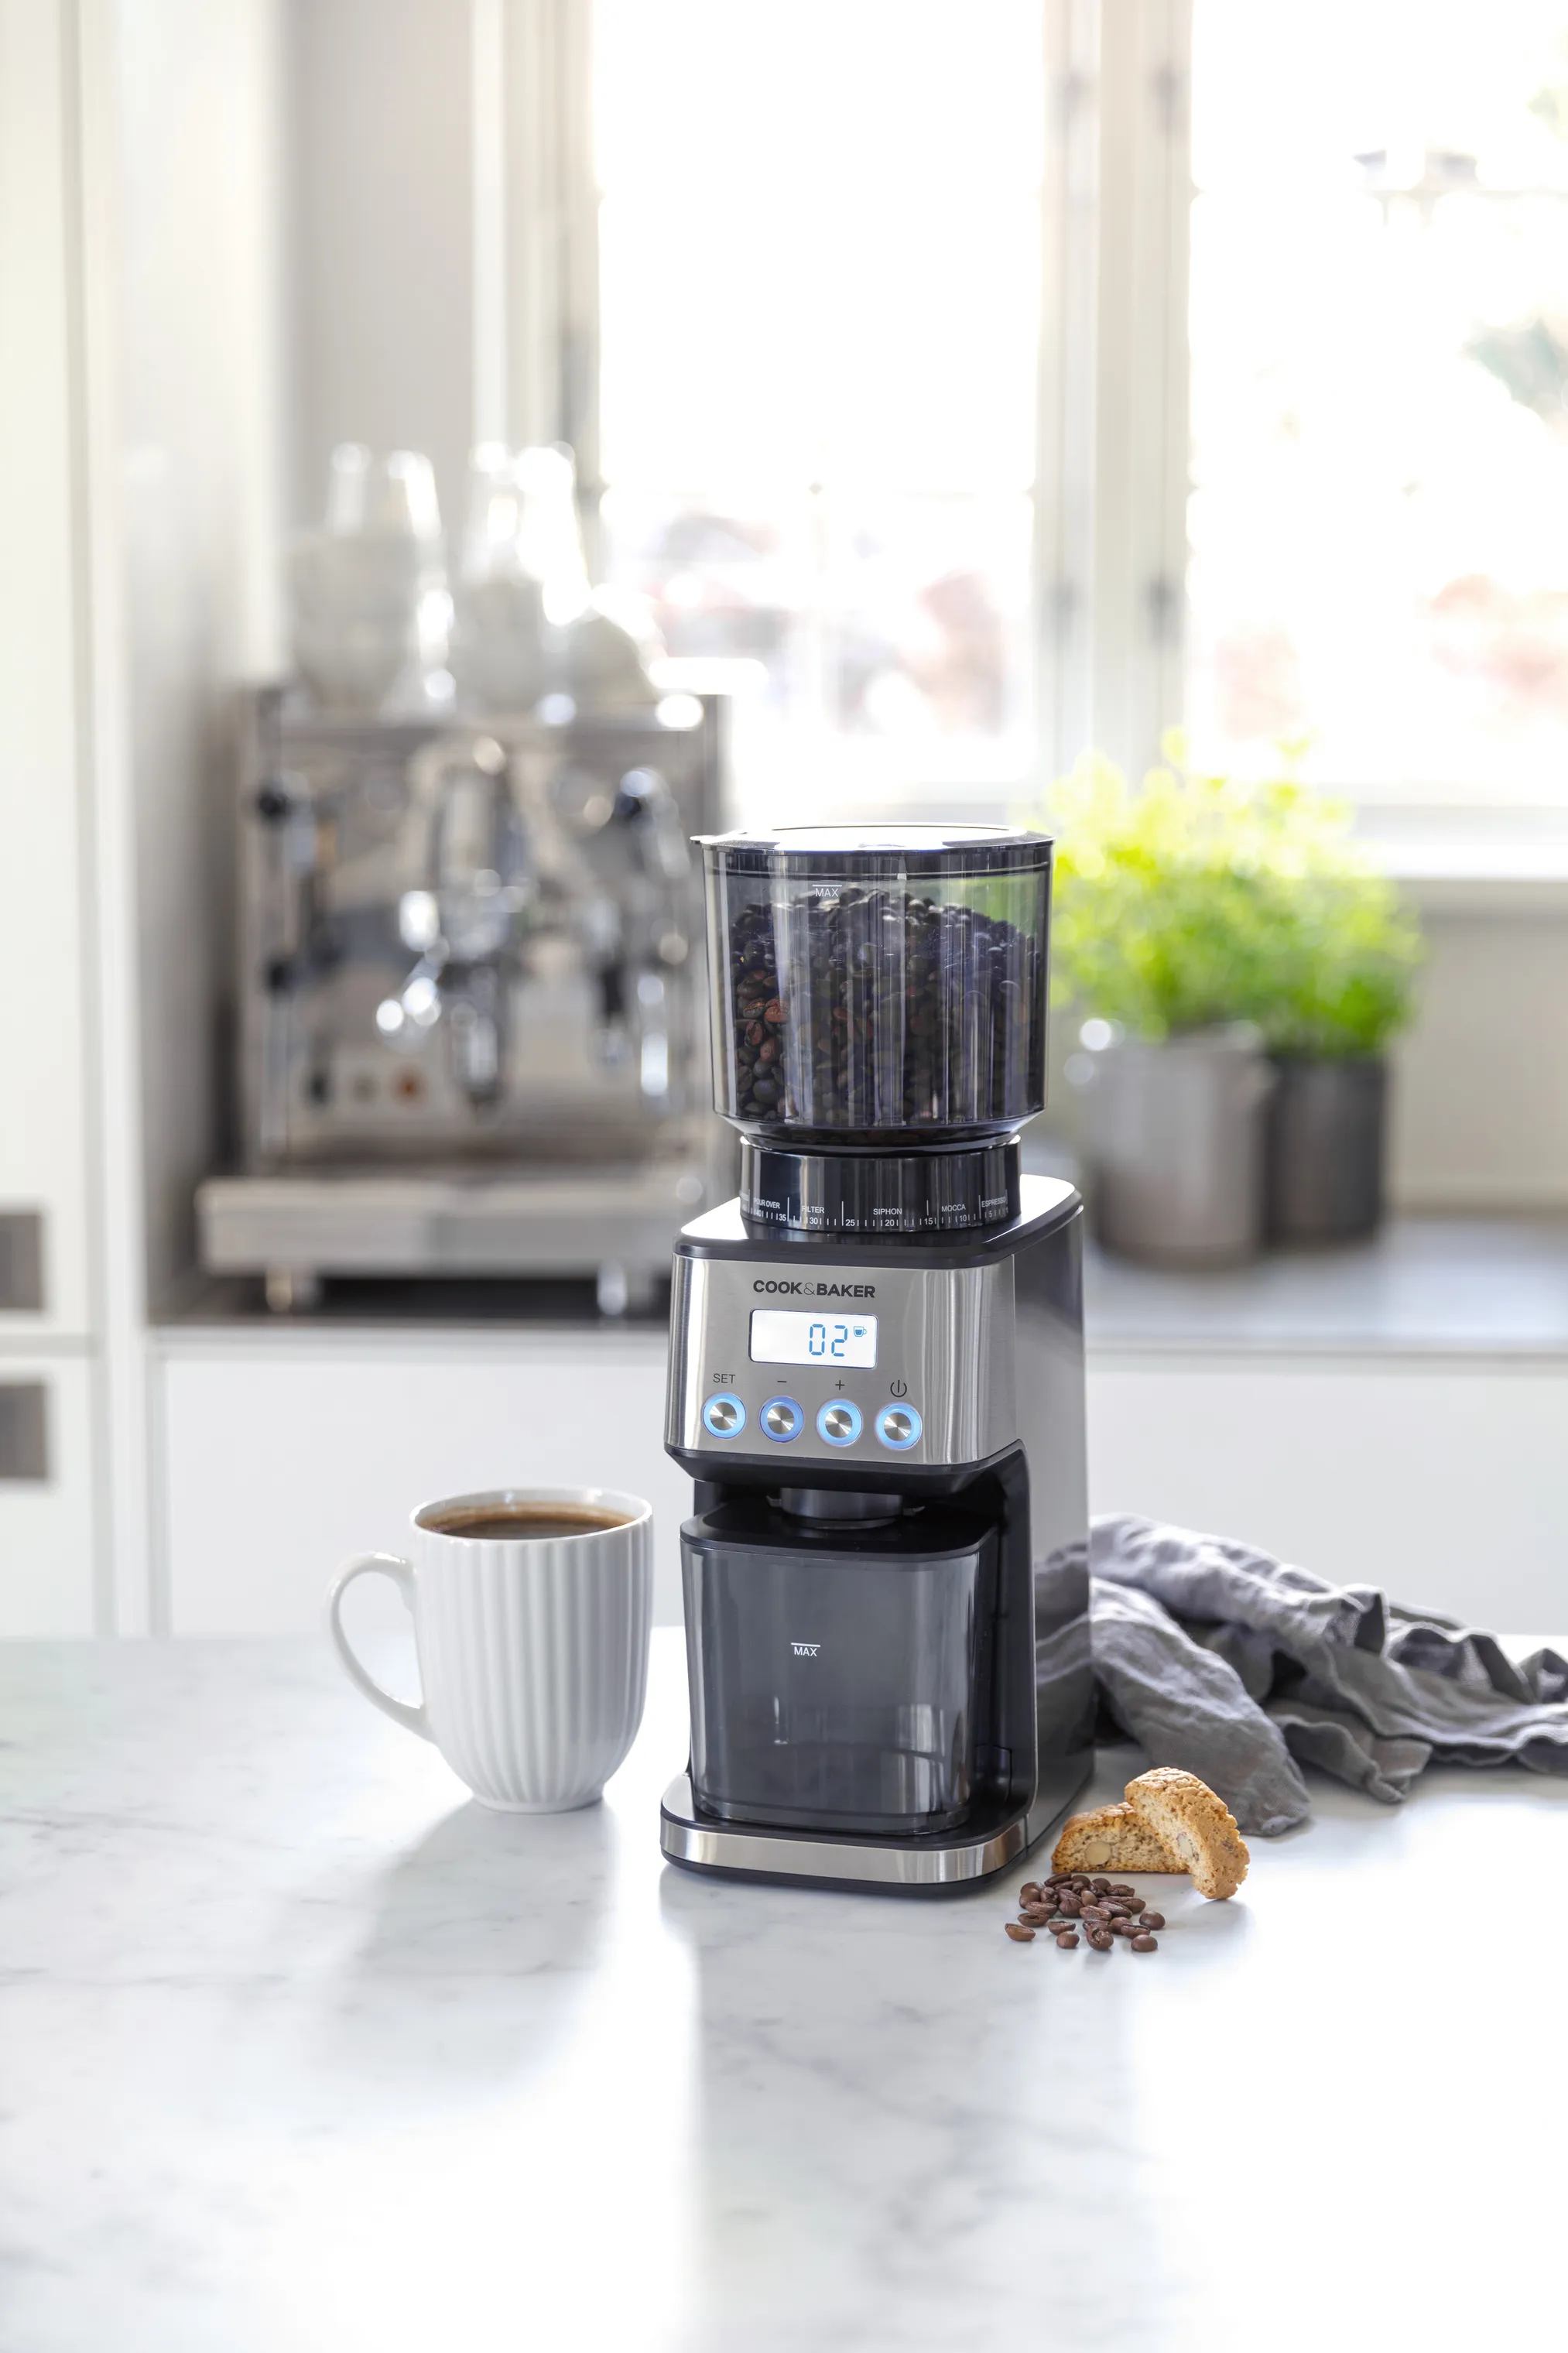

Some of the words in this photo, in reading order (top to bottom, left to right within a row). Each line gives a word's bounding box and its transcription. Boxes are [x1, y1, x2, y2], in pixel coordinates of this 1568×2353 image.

[815, 888, 839, 897] MAX
[766, 1200, 780, 1209] OVER
[981, 1196, 1006, 1207] ESPRESSO
[802, 1205, 825, 1214] FILTER
[941, 1204, 966, 1212] MOCCA
[779, 1213, 787, 1221] 35
[924, 1217, 933, 1225] 15
[960, 1214, 967, 1222] 10
[845, 1218, 855, 1227] 25
[885, 1218, 895, 1227] 20
[753, 1279, 876, 1298] COOK&BAKER
[809, 1324, 848, 1357] 02
[713, 1373, 736, 1384] SET
[794, 1646, 817, 1657] MAX
